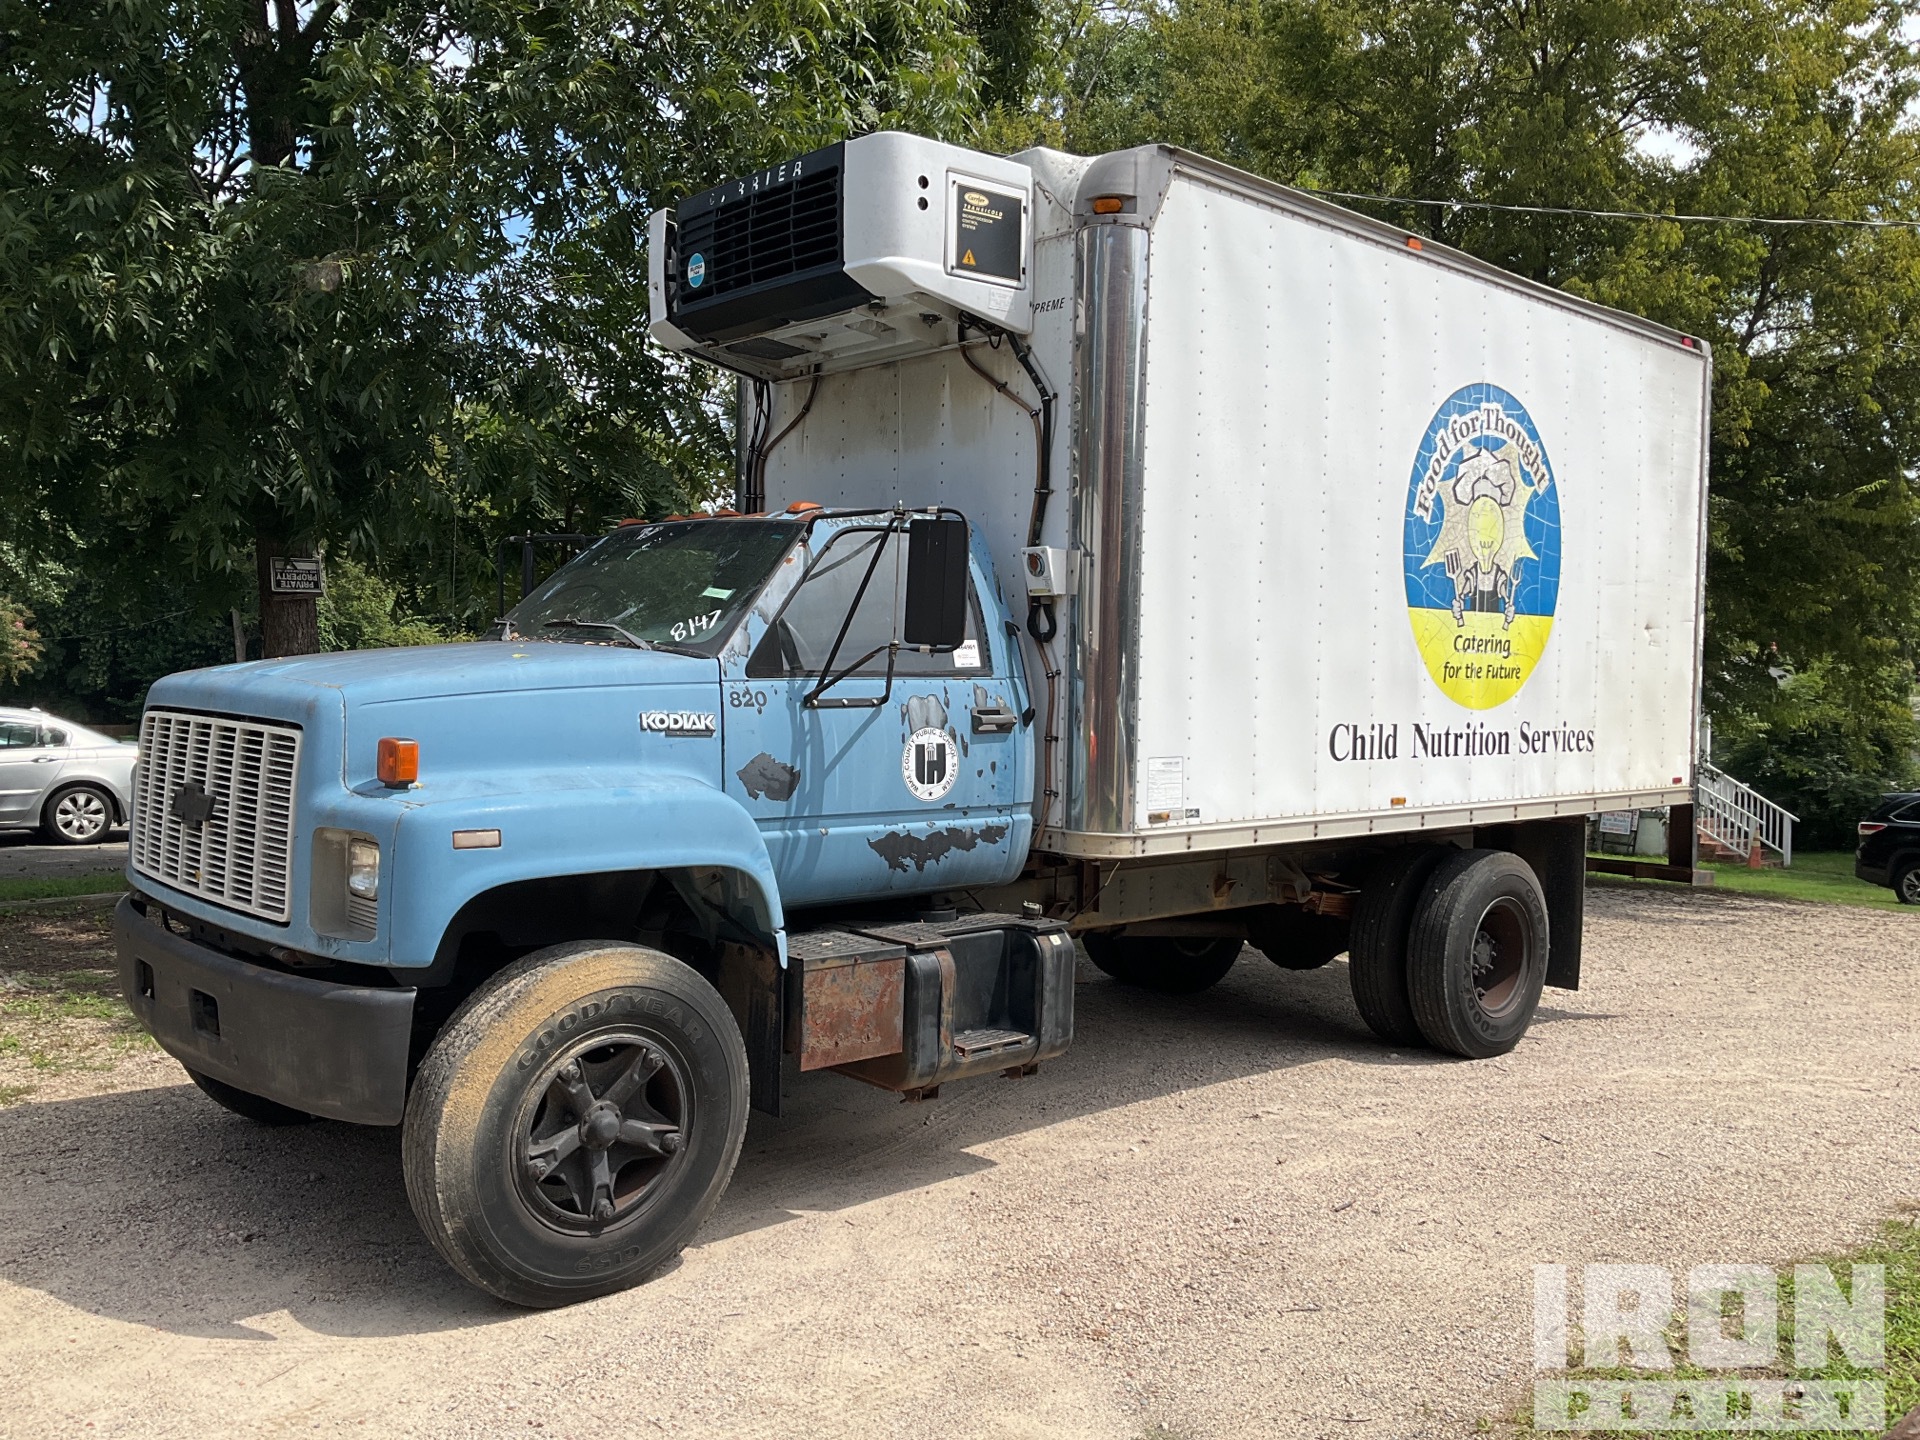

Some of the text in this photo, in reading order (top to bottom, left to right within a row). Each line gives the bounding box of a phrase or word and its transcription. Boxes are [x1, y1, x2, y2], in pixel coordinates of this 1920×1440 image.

[1417, 408, 1548, 515] Food for Thought
[276, 572, 318, 581] PROPERTY
[670, 609, 721, 641] 8147
[1453, 634, 1511, 659] Catering
[1443, 661, 1521, 683] for the Future
[729, 690, 767, 708] 820
[640, 712, 716, 731] KODIAK
[1329, 720, 1595, 762] Child Nutrition Services
[905, 728, 957, 793] WAKE COUNTY PUBLIC SCHOOL SYSTEM
[516, 993, 704, 1073] GOODYEAR
